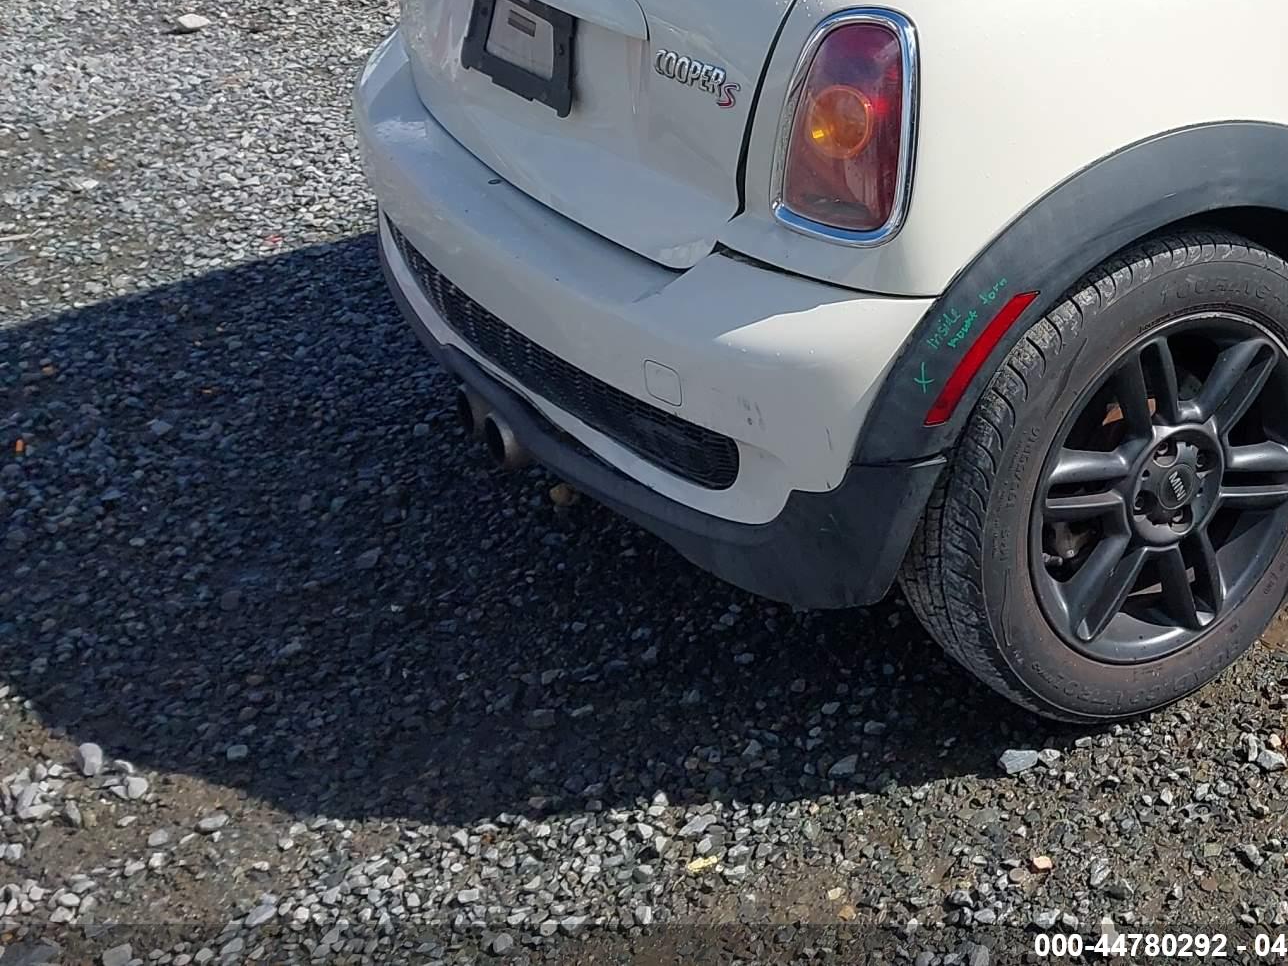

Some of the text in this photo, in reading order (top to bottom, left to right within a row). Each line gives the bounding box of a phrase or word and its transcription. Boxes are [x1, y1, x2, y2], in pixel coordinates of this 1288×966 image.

[655, 48, 741, 109] COOPER S
[1168, 470, 1187, 501] MINI
